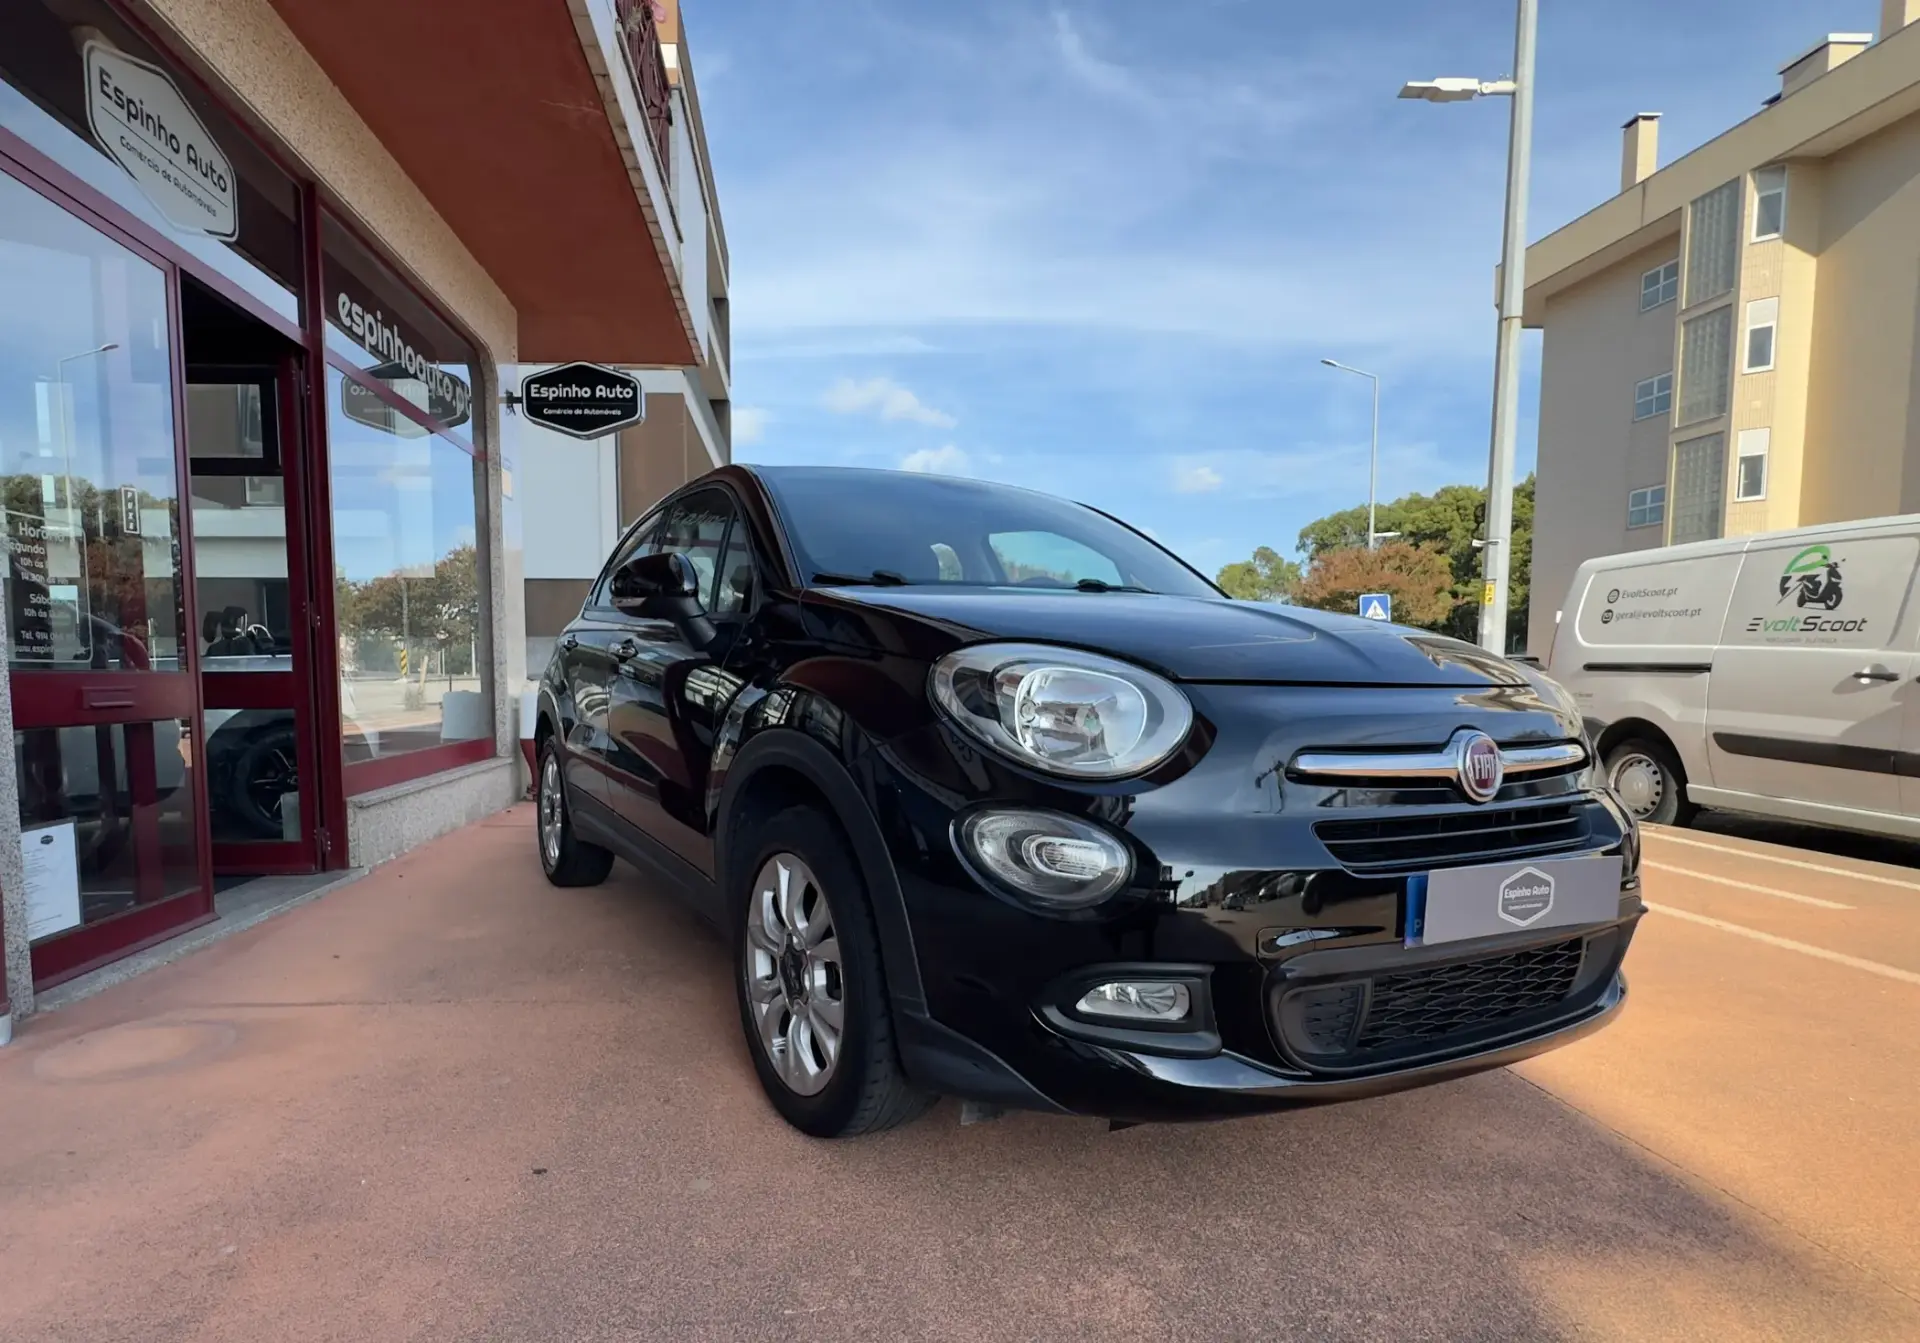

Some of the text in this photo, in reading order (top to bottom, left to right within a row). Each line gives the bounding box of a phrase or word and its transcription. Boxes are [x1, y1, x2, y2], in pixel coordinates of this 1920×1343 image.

[99, 65, 227, 193] Espinho Auto
[161, 169, 172, 183] de
[338, 293, 471, 416] espinhoauto.pt
[530, 384, 633, 401] Espinho Auto
[1621, 587, 1678, 599] EvoltScoot.pt
[1746, 616, 1868, 632] EvoltScoot
[1474, 754, 1496, 779] FIAT
[1532, 885, 1549, 895] Auto
[1414, 919, 1422, 933] P
